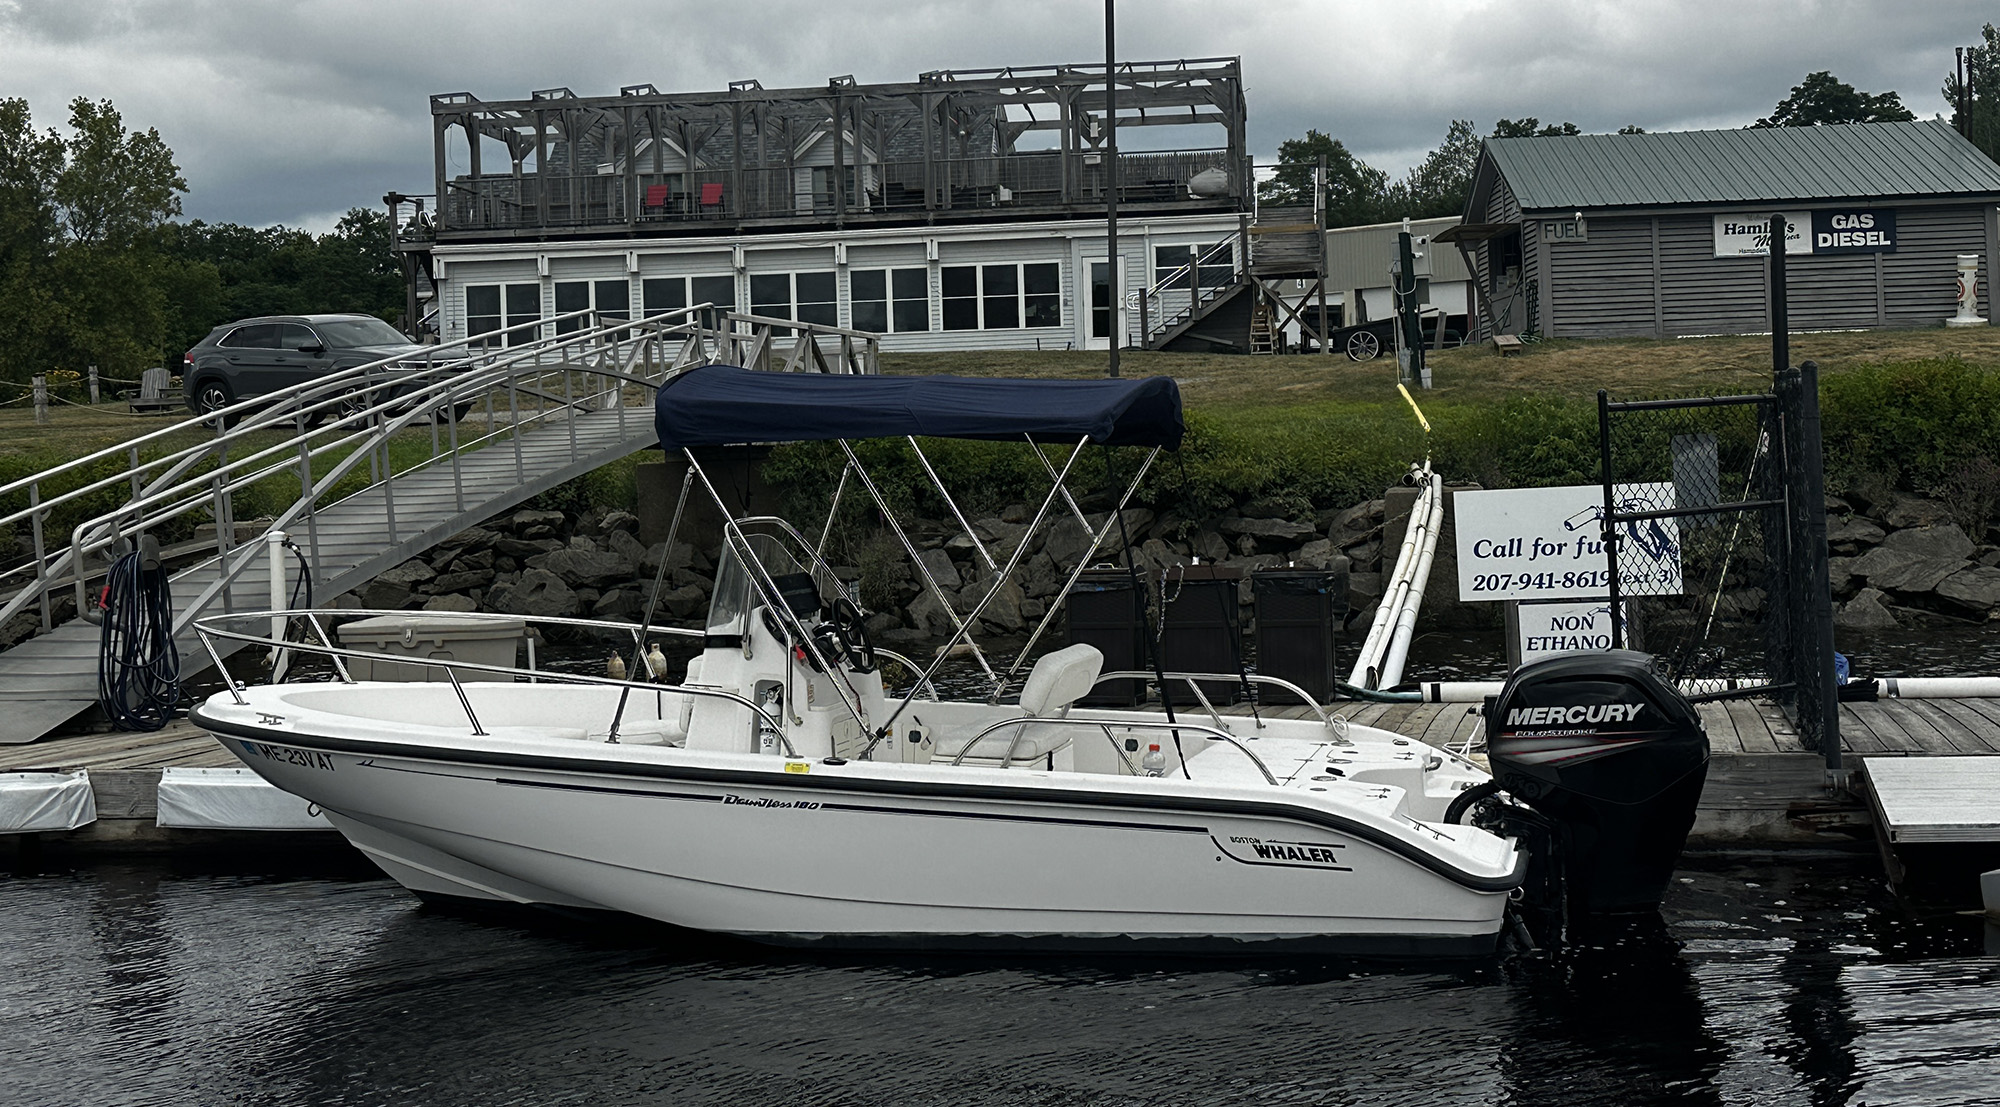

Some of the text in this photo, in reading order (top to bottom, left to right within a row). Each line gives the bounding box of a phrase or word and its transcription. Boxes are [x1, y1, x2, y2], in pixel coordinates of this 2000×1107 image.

[1544, 222, 1584, 239] FUEL
[1723, 221, 1795, 235] Haml's
[1831, 214, 1875, 230] GAS
[1817, 231, 1891, 248] DIESEL
[1473, 534, 1625, 561] Call for ful
[1472, 570, 1610, 591] 207-941-8619
[1550, 616, 1595, 632] NON
[1526, 635, 1611, 651] ETHANO
[1506, 703, 1645, 726] MERCURY
[257, 743, 286, 762] ME
[793, 801, 819, 809] 180
[1229, 836, 1261, 845] BOSTON
[1252, 844, 1337, 864] WHALER
